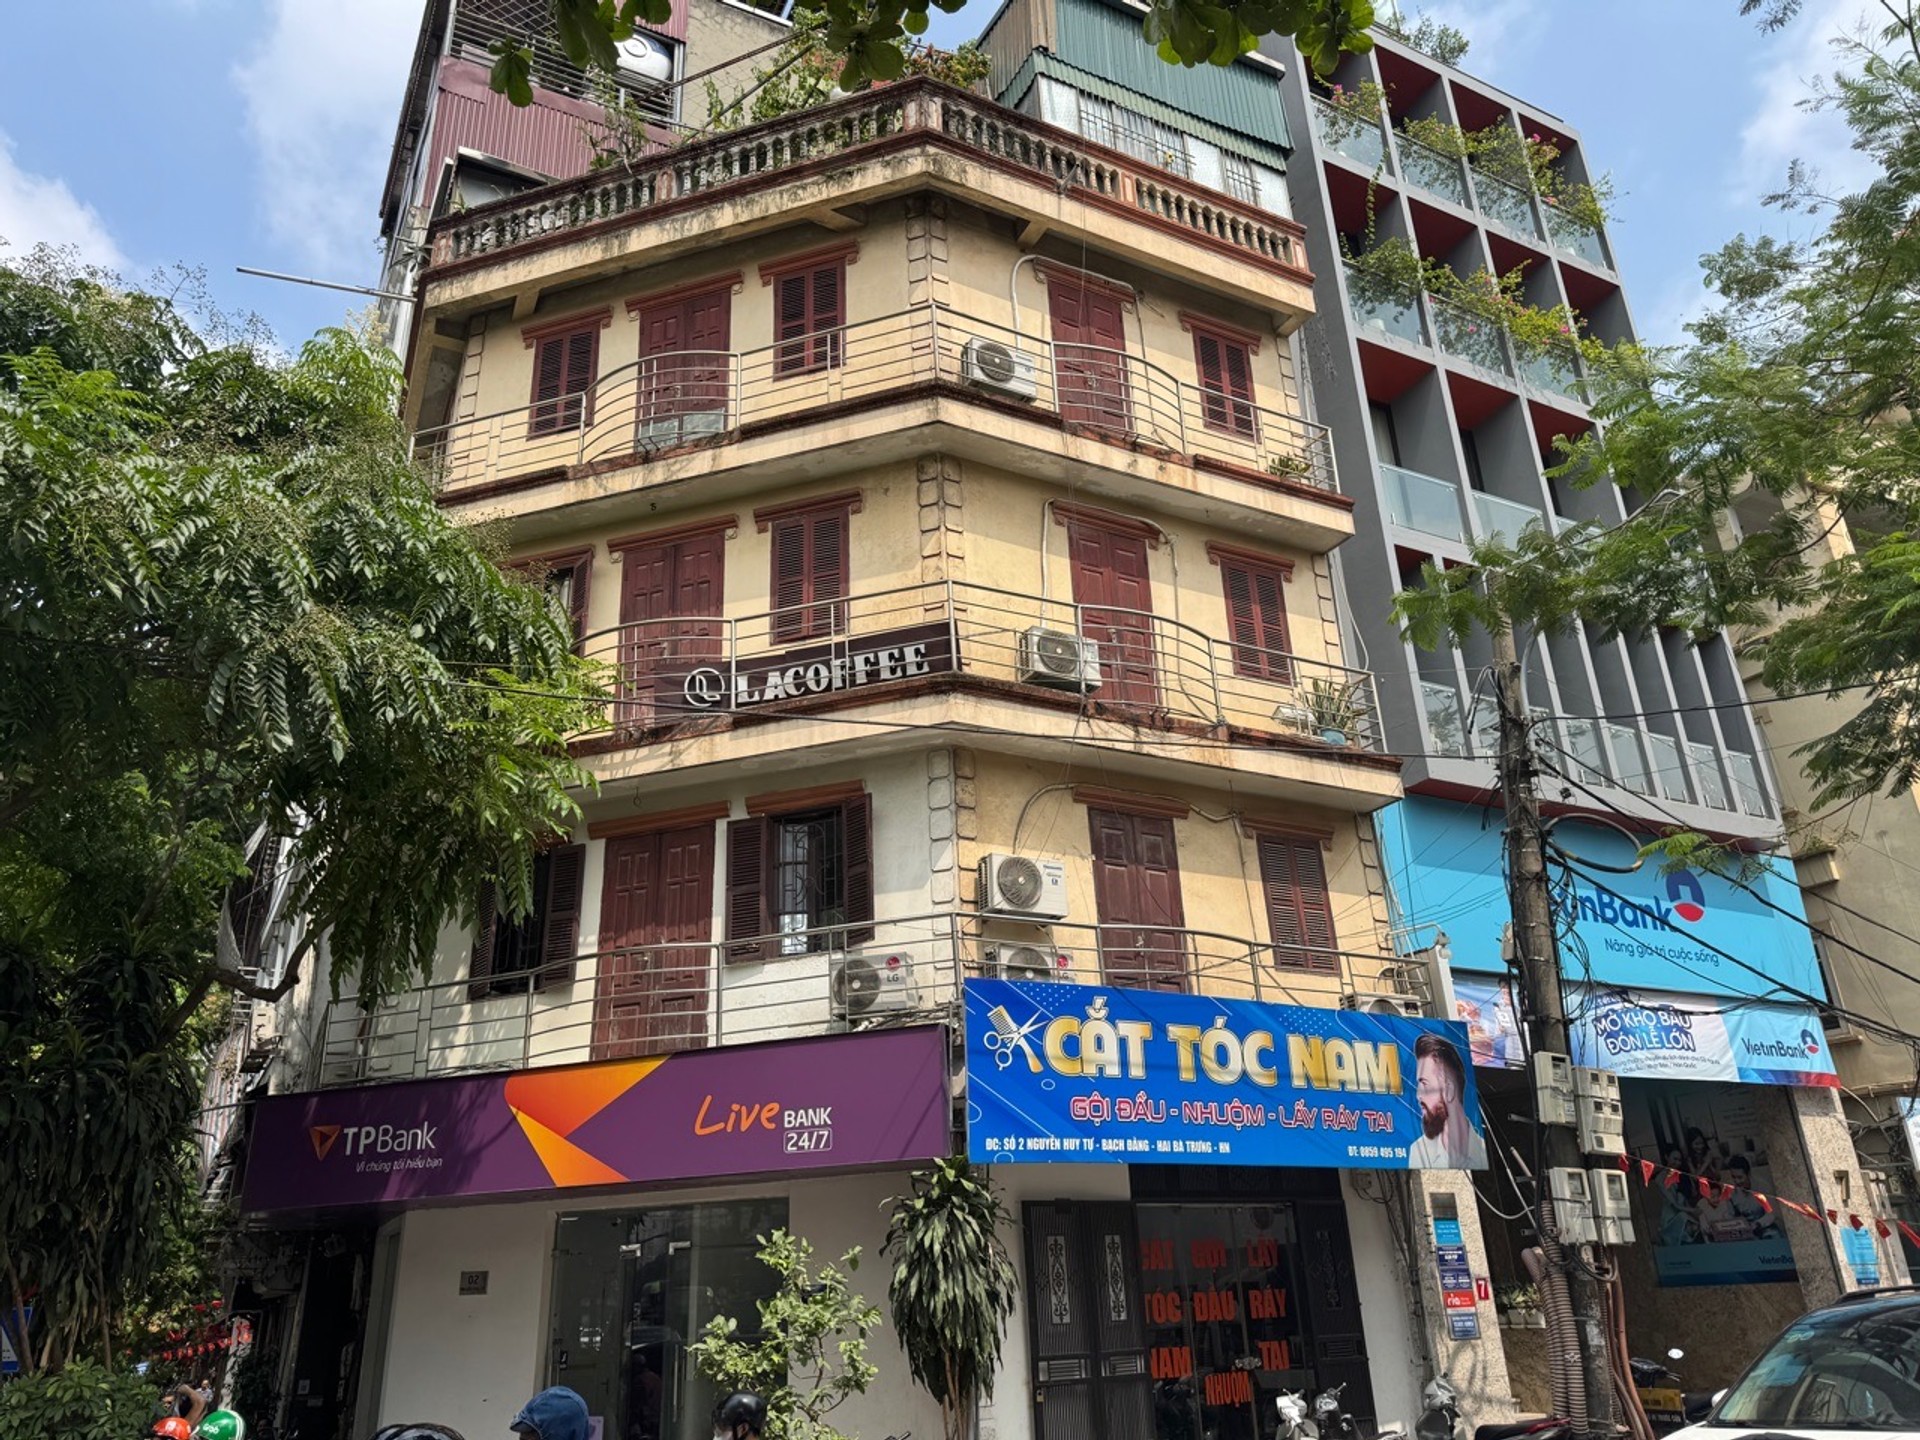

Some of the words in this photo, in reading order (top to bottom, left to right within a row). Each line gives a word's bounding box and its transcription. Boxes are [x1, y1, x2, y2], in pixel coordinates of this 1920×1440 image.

[1604, 938, 1635, 957] Nâng
[1668, 946, 1693, 964] cuộc
[1694, 948, 1720, 967] sống
[887, 973, 900, 982] LG
[1593, 1010, 1621, 1035] MỞ
[1621, 1010, 1657, 1028] KHO
[1043, 996, 1153, 1080] CẮT
[1166, 1015, 1278, 1086] TÓC
[1286, 1032, 1404, 1096] NAM
[1606, 1033, 1640, 1055] ĐÓN
[1642, 1025, 1660, 1048] LỄ
[1661, 1028, 1695, 1051] LỚN
[1741, 1037, 1809, 1060] VietinBank
[694, 1094, 780, 1136] Live
[784, 1107, 832, 1128] BANK
[1070, 1091, 1111, 1126] GỘI
[1115, 1091, 1167, 1123] ĐẦU
[1182, 1098, 1265, 1131] NHUỘM
[1278, 1098, 1318, 1129] LẤY
[1321, 1104, 1360, 1131] RÁY
[1362, 1110, 1394, 1132] TAI
[343, 1121, 438, 1156] TPBank
[786, 1130, 830, 1151] 24/7
[1018, 1137, 1025, 1150] 2
[1063, 1137, 1081, 1151] HUY
[1157, 1139, 1172, 1152] HAI
[468, 1275, 480, 1285] 02
[1478, 1280, 1487, 1298] 7
[1248, 1284, 1287, 1320] RÁY
[1257, 1339, 1290, 1372] TAI
[1205, 1365, 1252, 1408] NHUỘM
